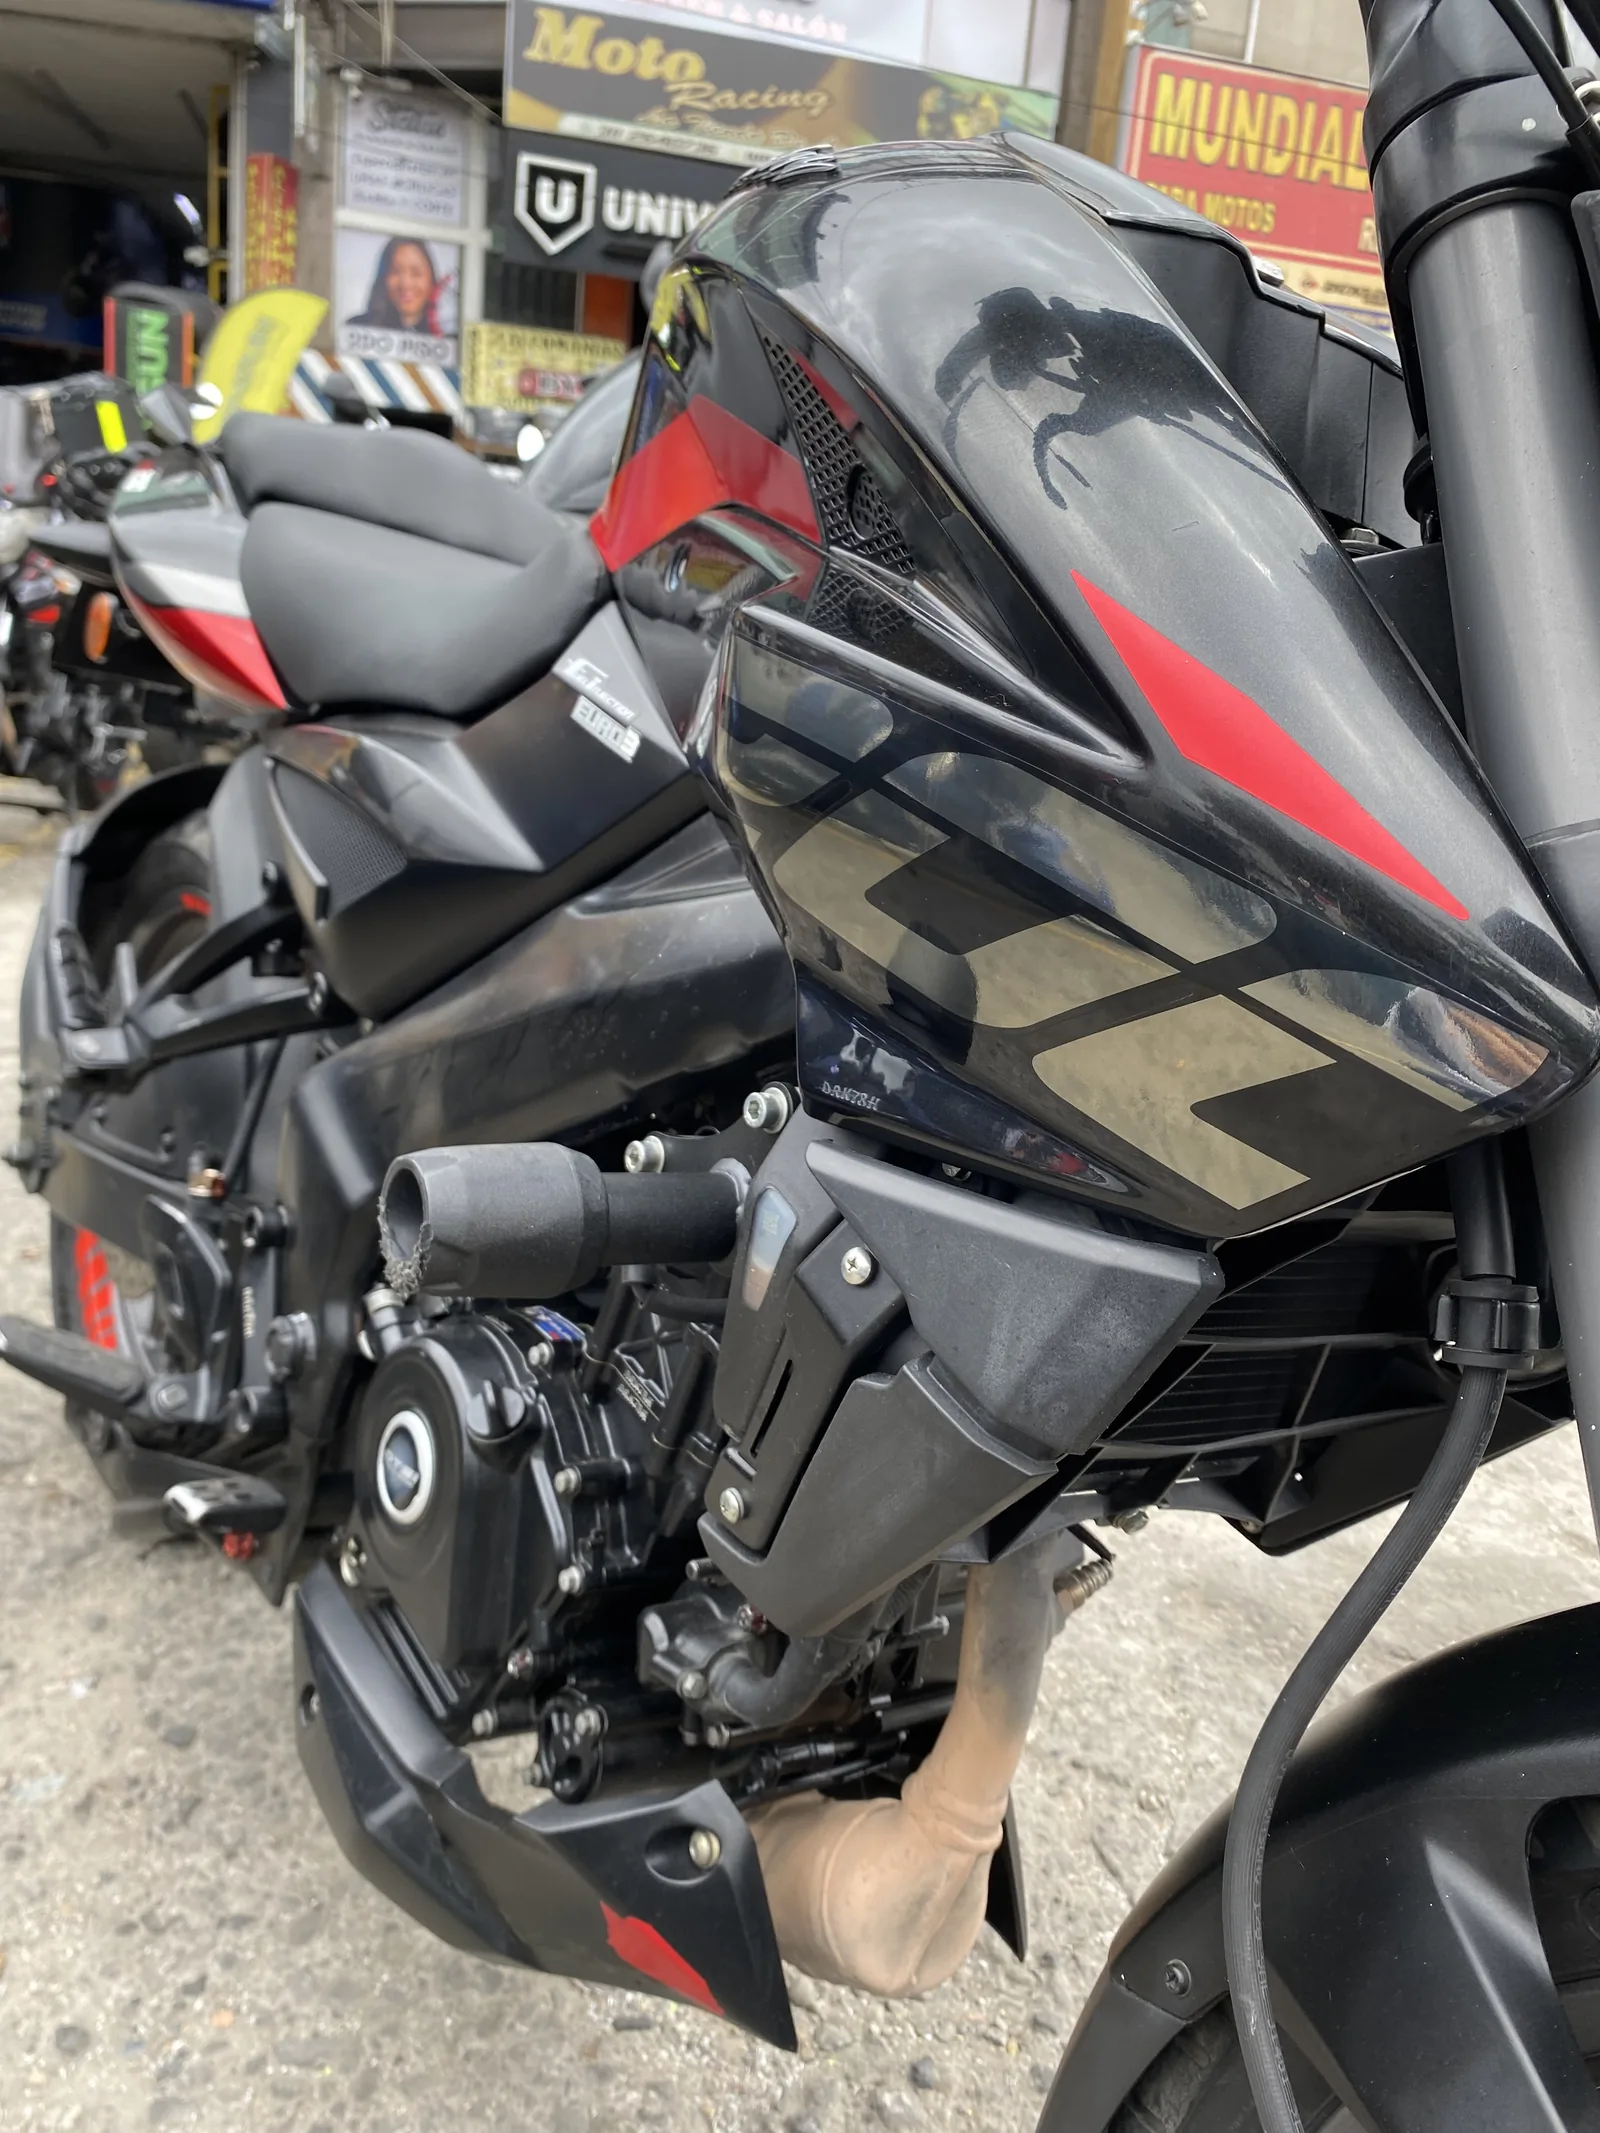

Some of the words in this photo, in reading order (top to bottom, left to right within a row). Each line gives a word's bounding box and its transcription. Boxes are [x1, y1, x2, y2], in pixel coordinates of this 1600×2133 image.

[526, 8, 706, 81] Moto
[664, 80, 831, 118] Racing
[1151, 73, 1369, 191] MUNDIAL
[535, 175, 577, 224] U
[1203, 191, 1277, 234] MOTOS
[822, 1079, 881, 1112] DRK78H
